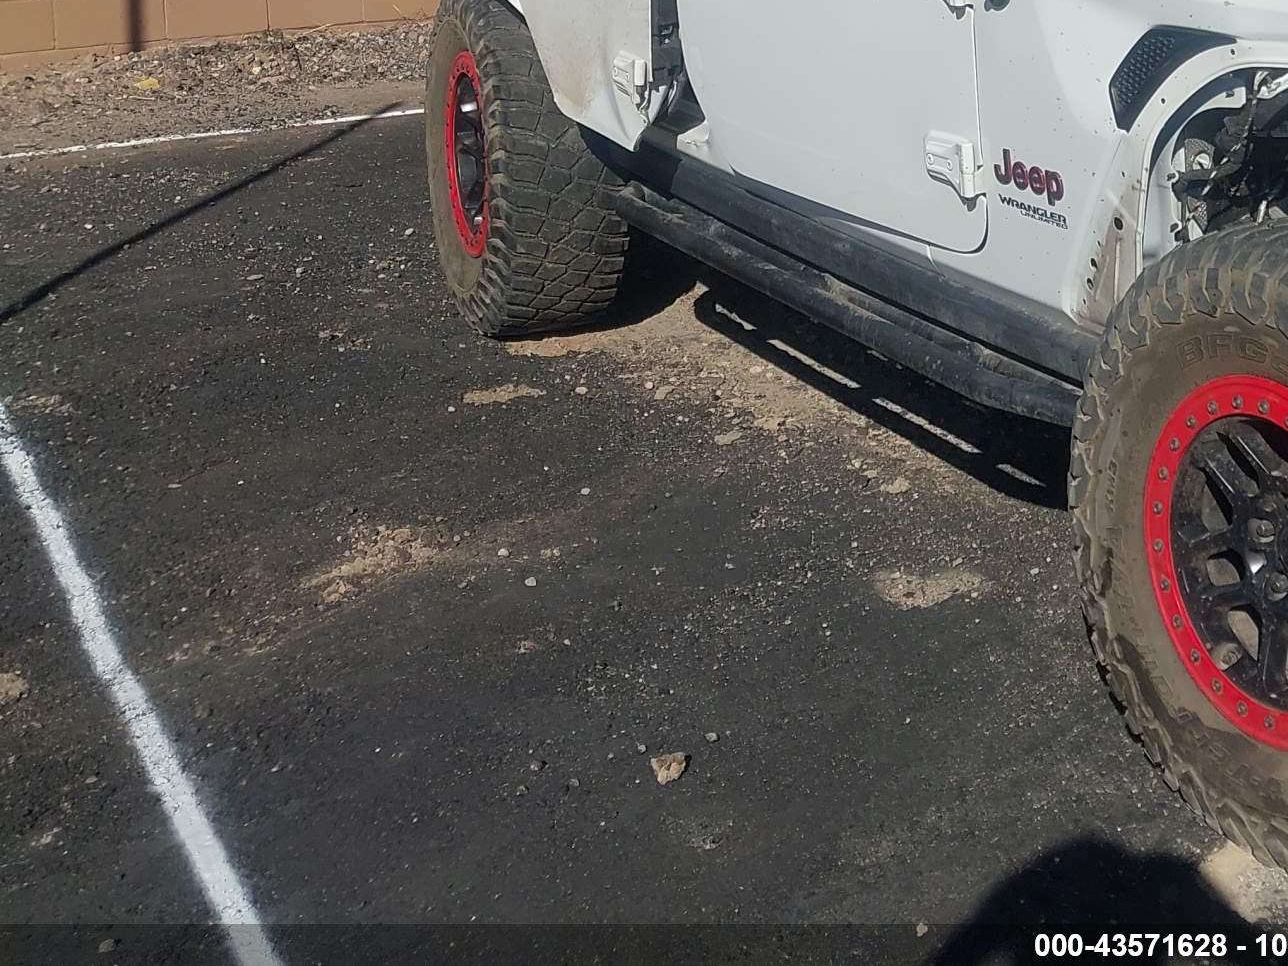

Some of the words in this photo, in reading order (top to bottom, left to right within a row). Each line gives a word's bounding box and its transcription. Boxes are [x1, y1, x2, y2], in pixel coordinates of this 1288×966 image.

[992, 147, 1065, 208] Jeep
[998, 193, 1068, 226] WRANGLER
[1020, 209, 1069, 231] UNLIMITED
